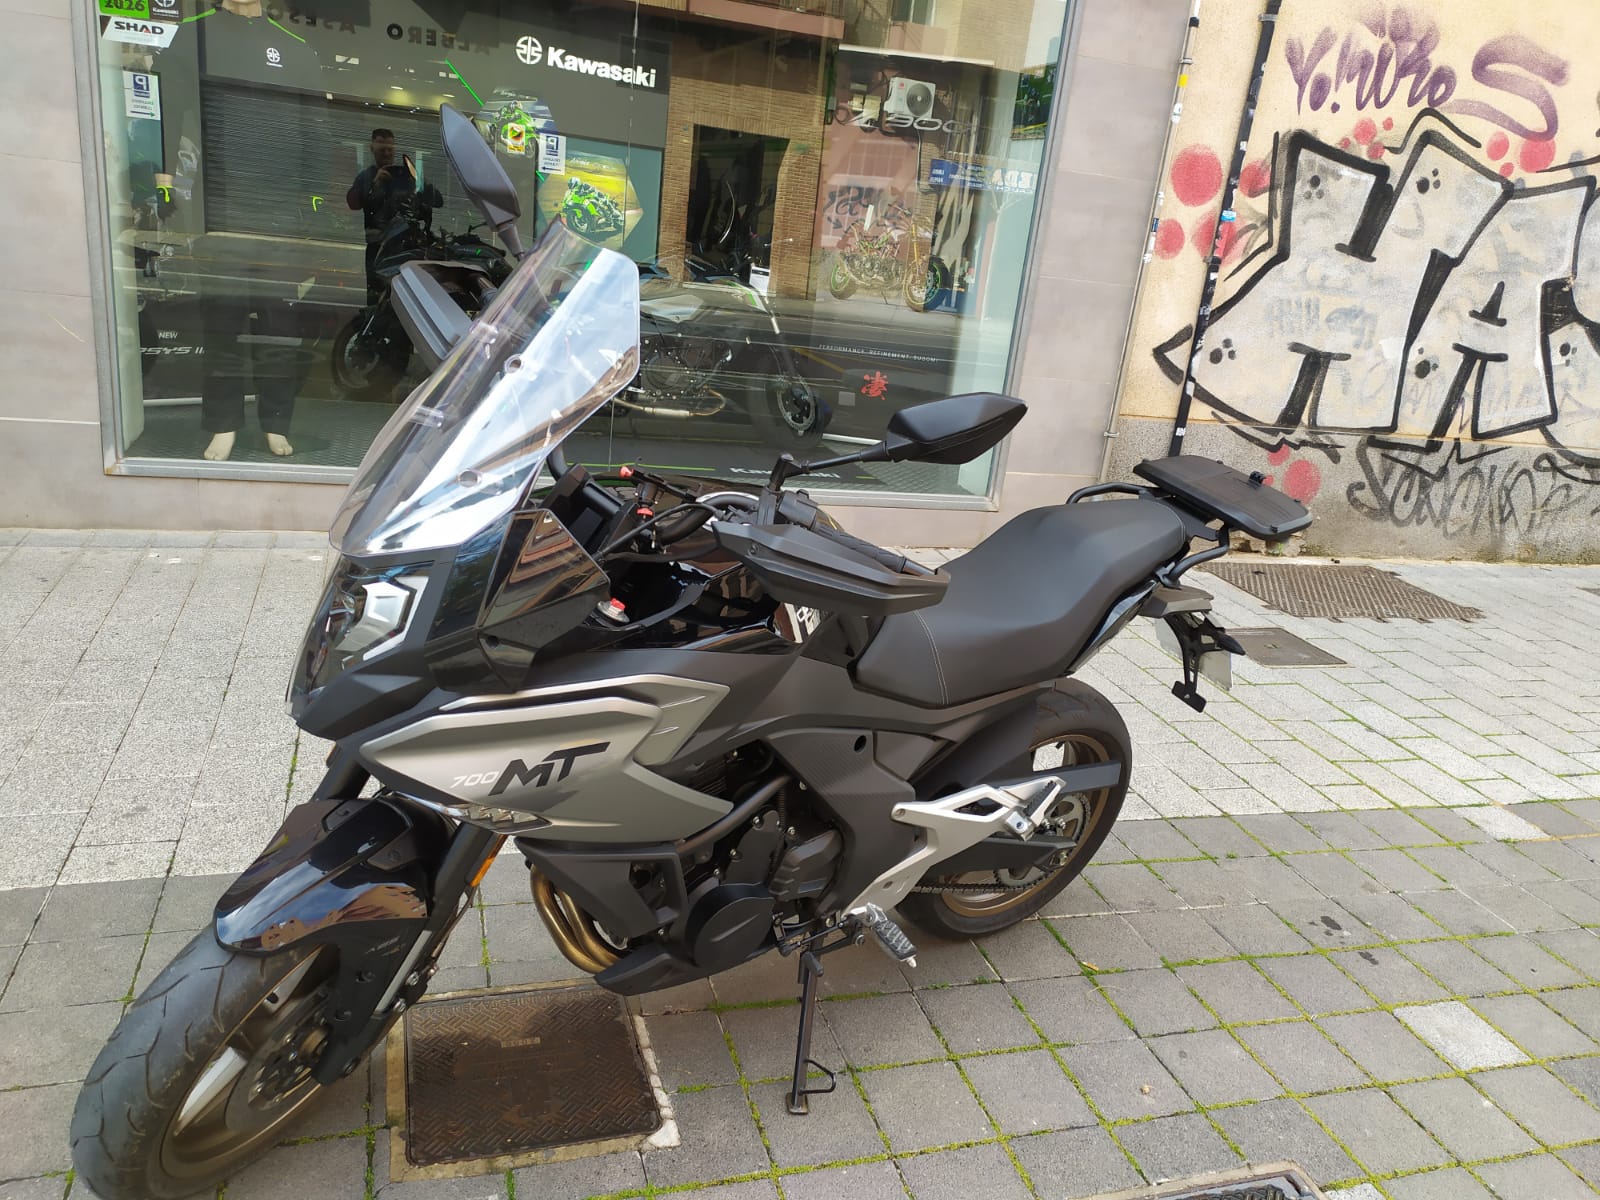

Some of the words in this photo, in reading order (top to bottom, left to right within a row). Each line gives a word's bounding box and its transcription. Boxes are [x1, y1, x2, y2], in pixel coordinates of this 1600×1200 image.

[113, 20, 165, 35] SHAD
[547, 46, 657, 88] Kawasaki
[158, 331, 178, 339] NEW
